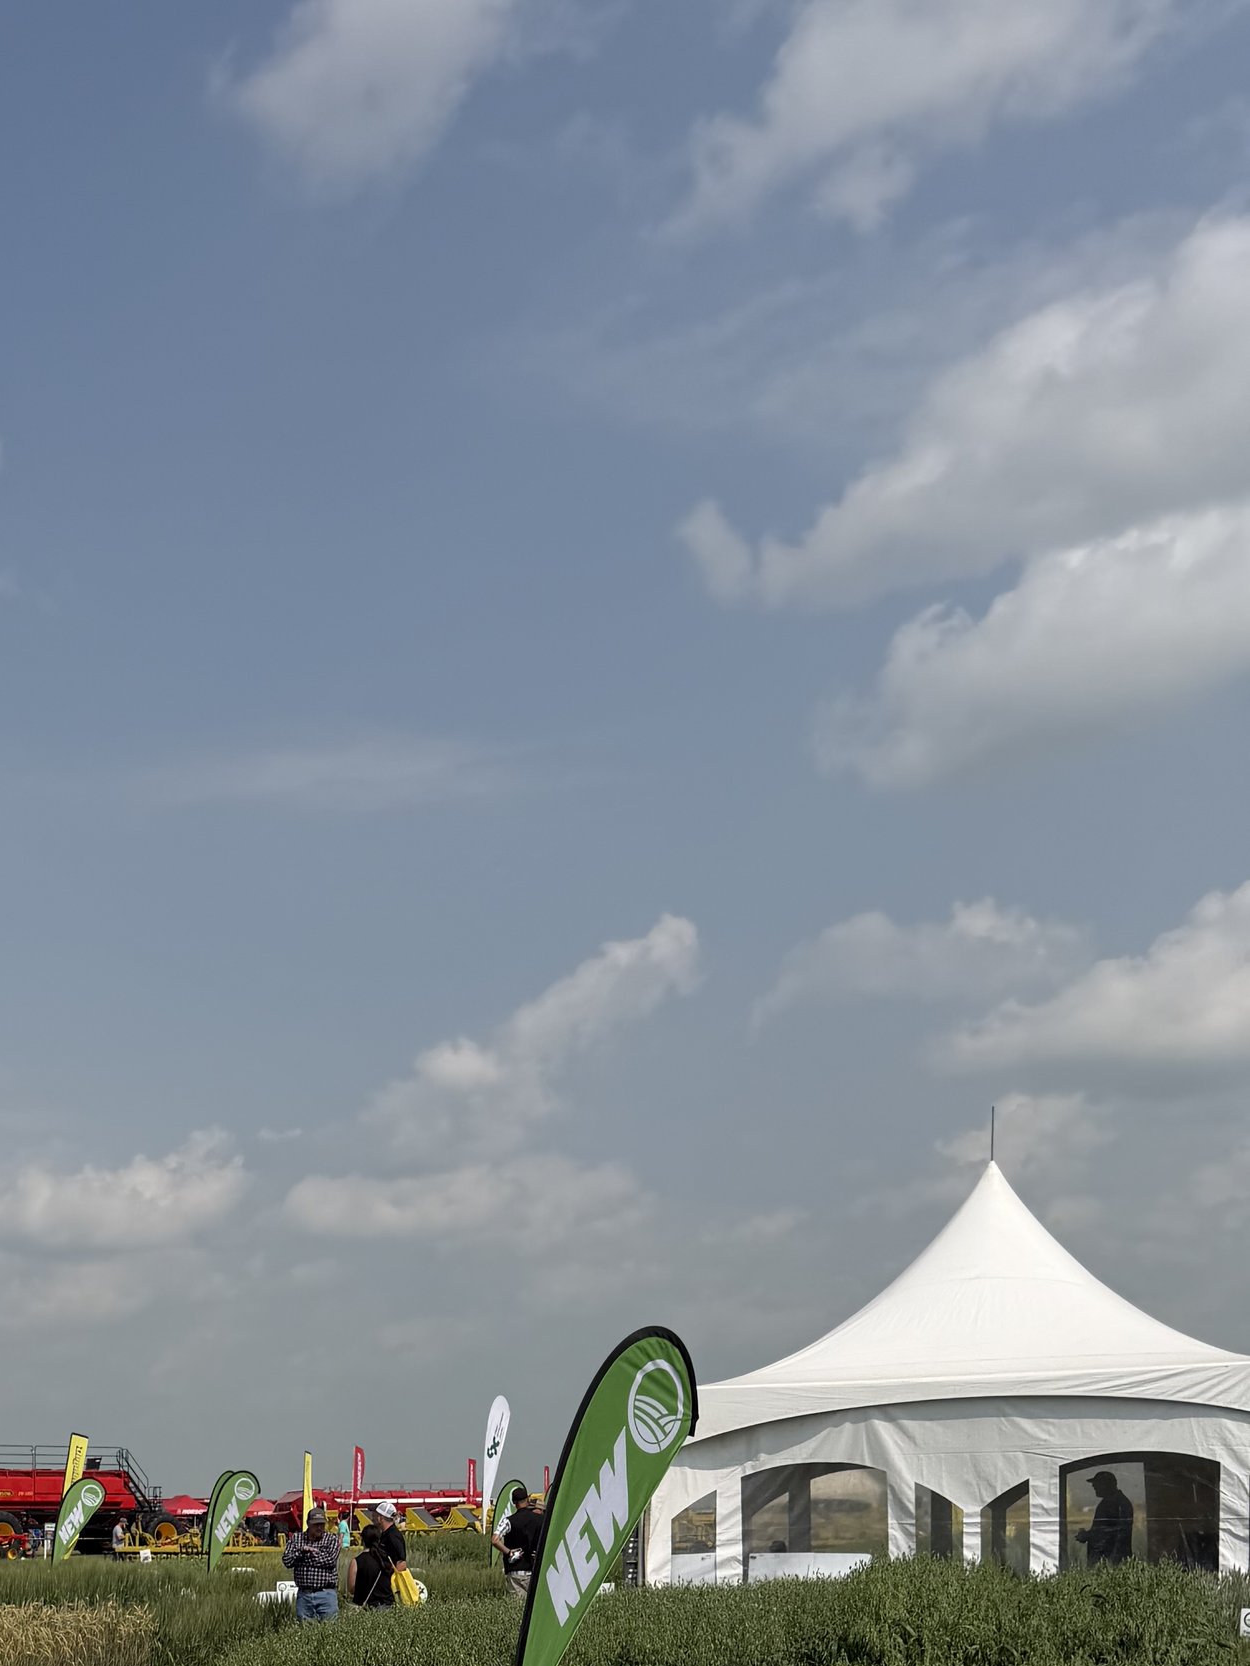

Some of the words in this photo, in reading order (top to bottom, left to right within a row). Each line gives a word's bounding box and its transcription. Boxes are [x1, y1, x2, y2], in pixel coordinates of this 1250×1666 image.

[58, 1500, 85, 1545] NEW
[214, 1495, 240, 1543] NEW
[546, 1426, 629, 1627] NEW
